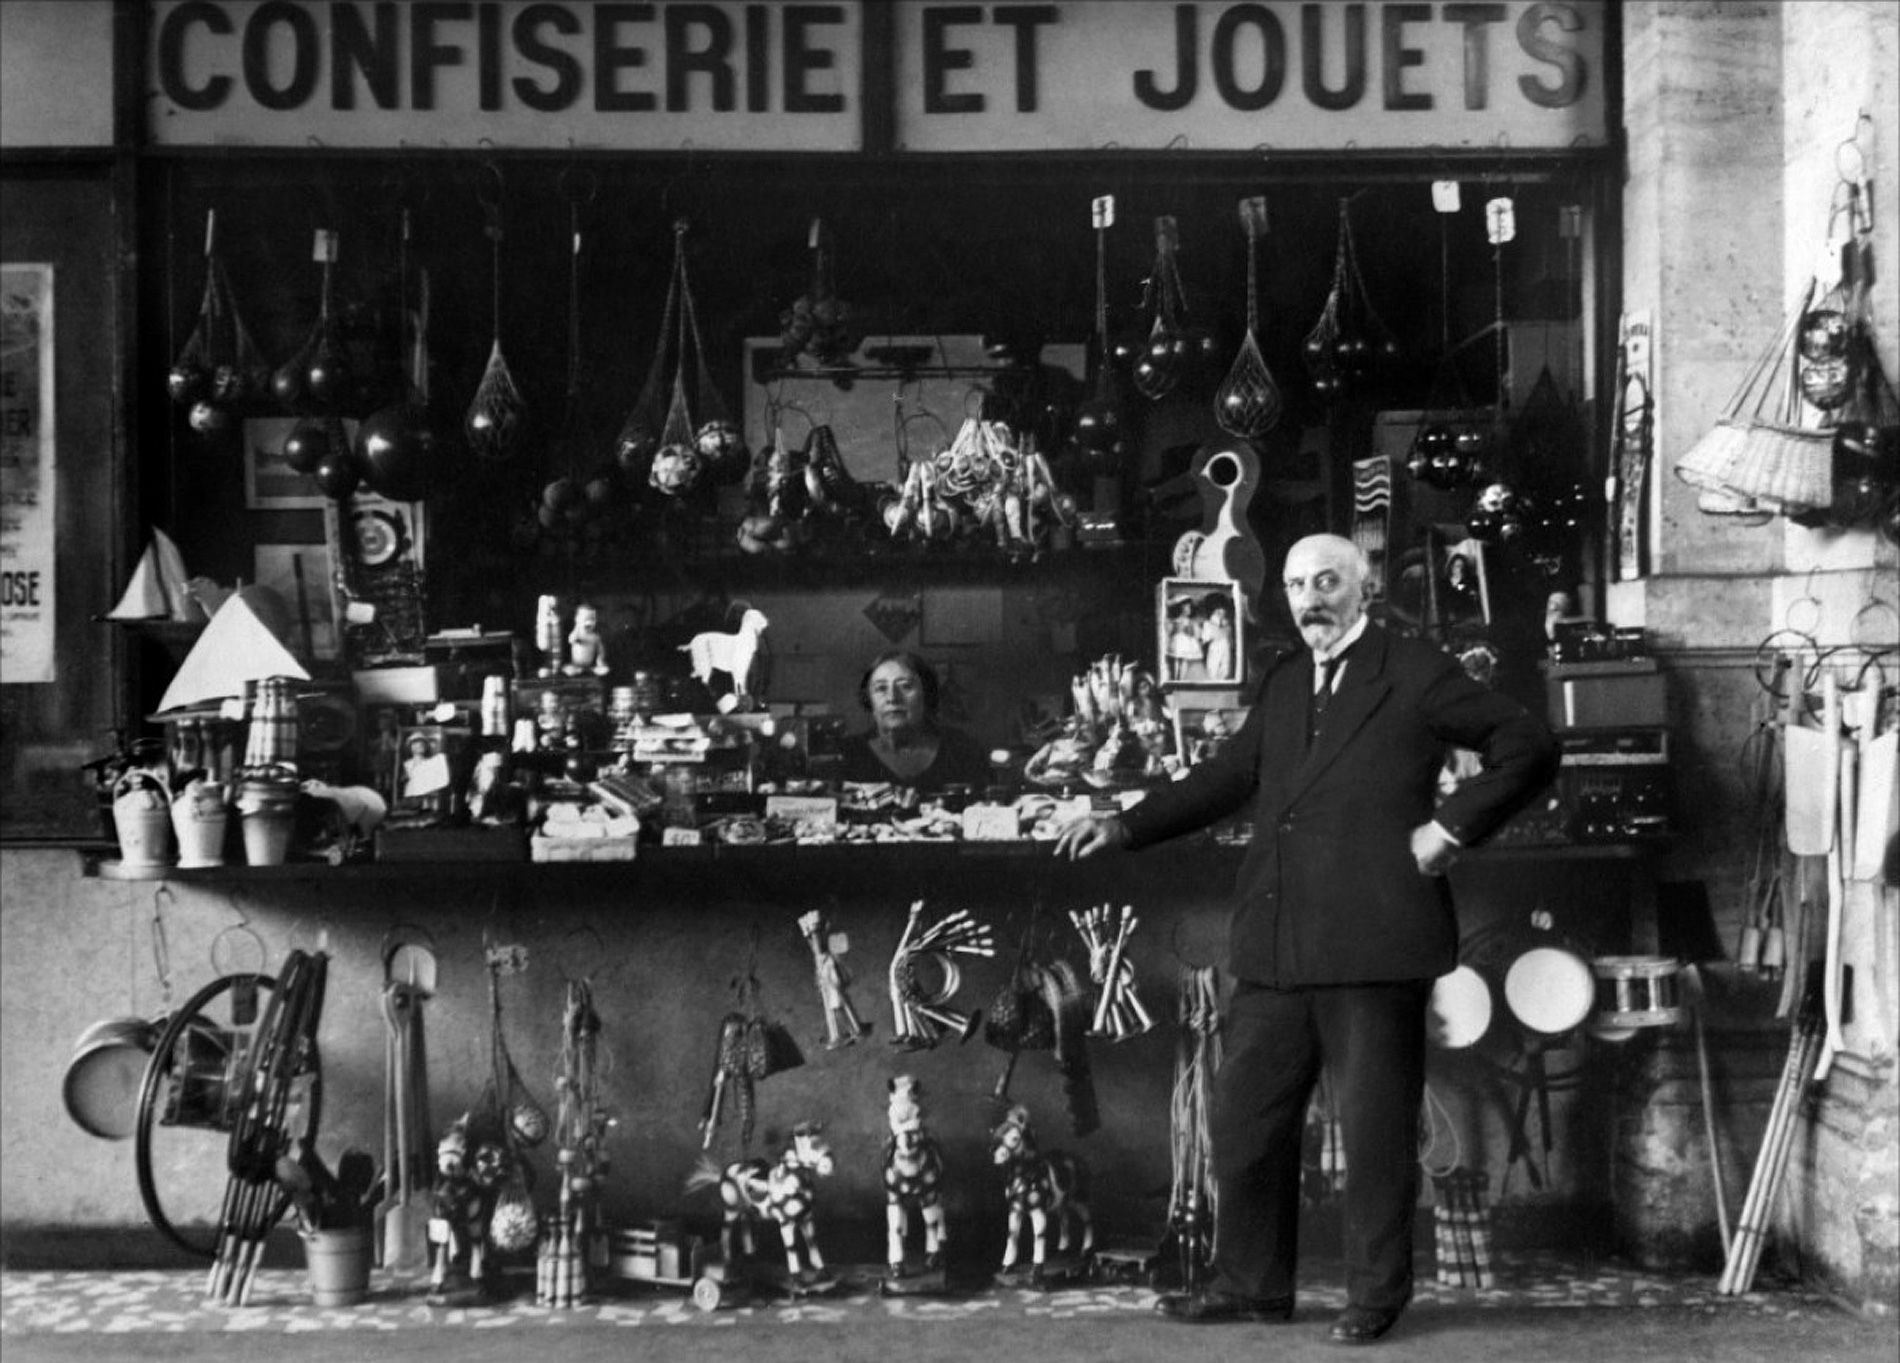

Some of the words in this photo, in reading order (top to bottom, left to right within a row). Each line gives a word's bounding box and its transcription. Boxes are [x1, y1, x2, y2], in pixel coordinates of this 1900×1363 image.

[158, 0, 847, 113] CONFISERIE
[922, 4, 1060, 114] ET
[1133, 2, 1587, 112] JOUETS
[1, 570, 40, 607] OSE
